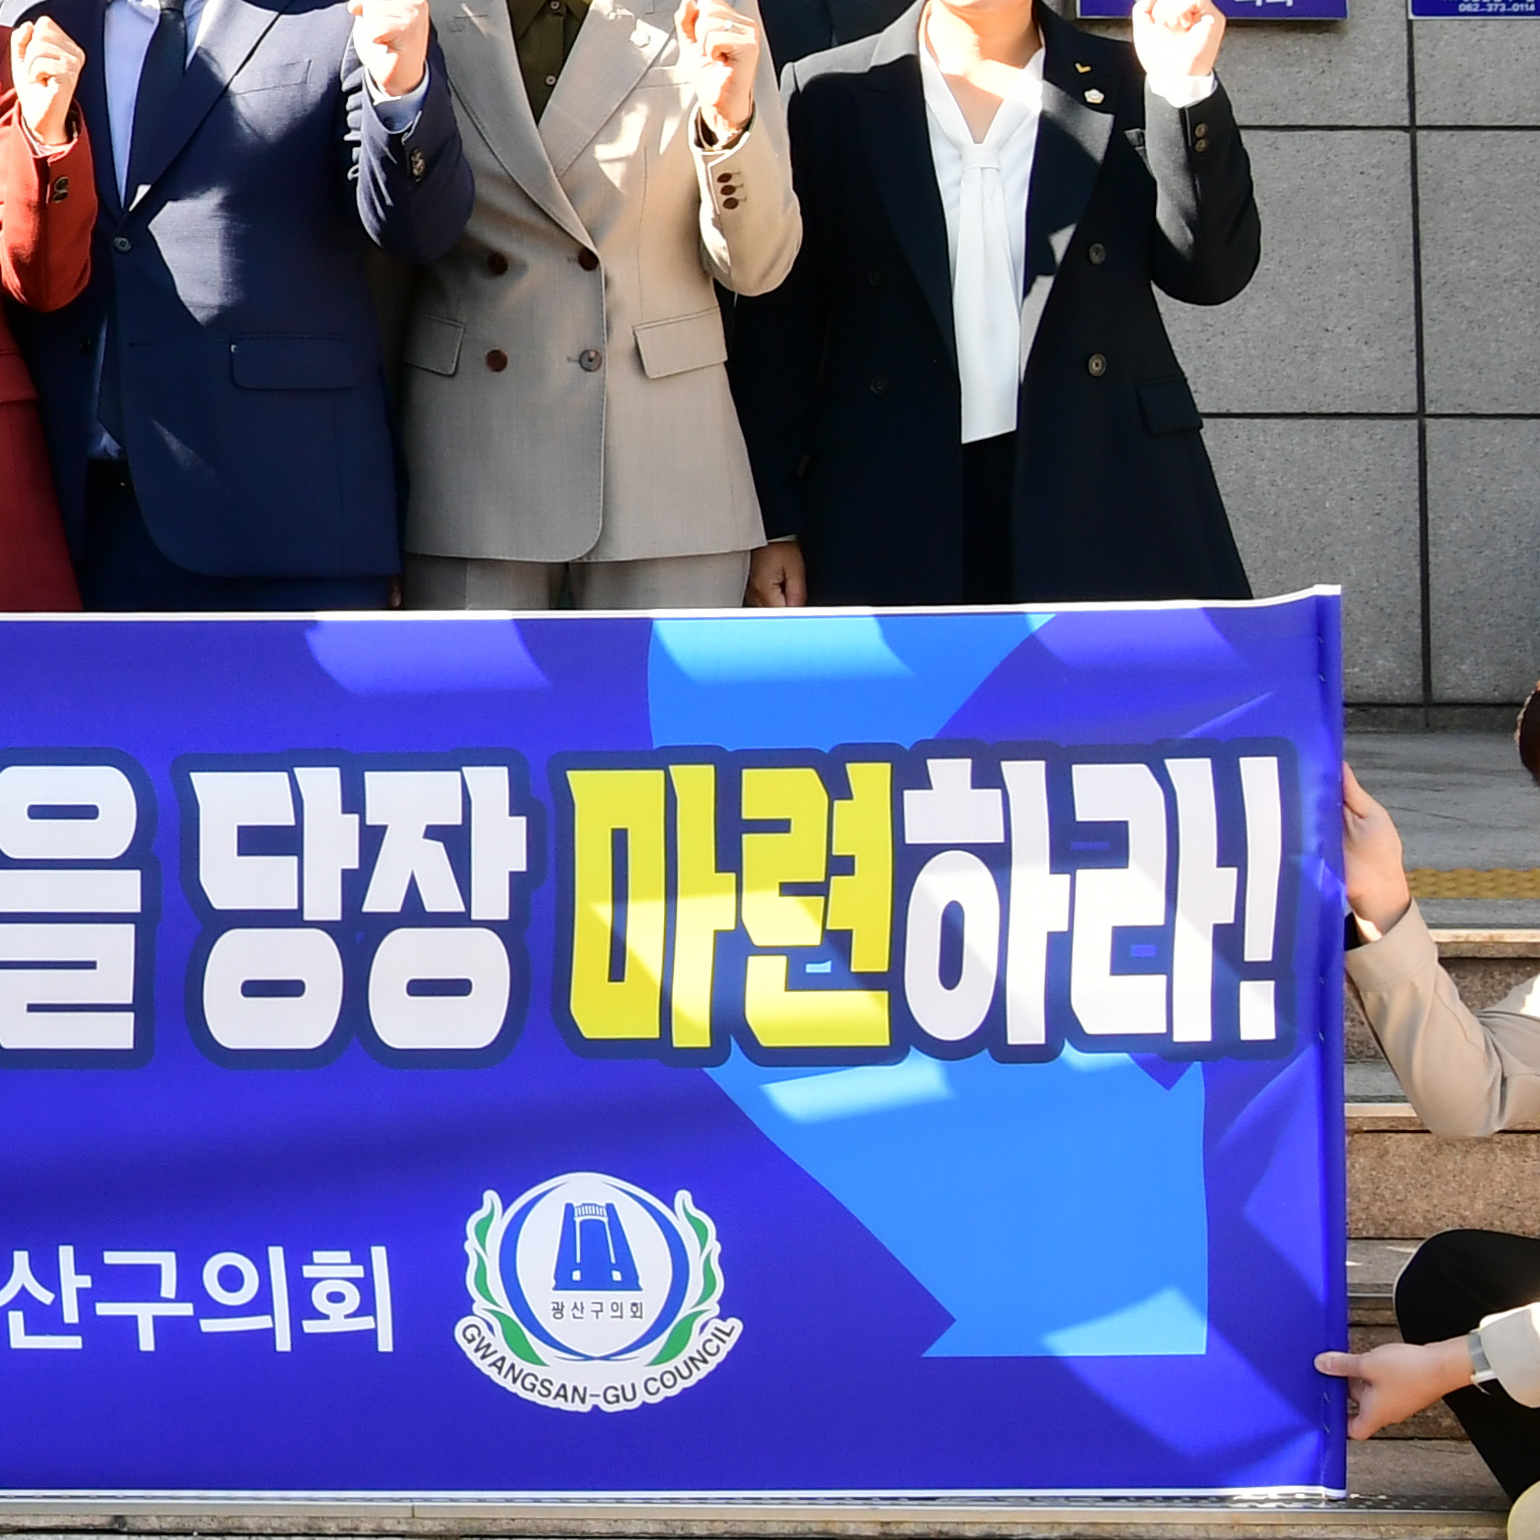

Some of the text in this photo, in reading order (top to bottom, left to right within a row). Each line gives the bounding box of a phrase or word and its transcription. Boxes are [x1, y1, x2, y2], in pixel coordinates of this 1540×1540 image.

[190, 766, 527, 1050] 당장
[567, 757, 1282, 1050] 마련하라!
[551, 1300, 645, 1321] 광산구의회
[461, 1320, 736, 1405] GWANGSAN-GU COUNCIL
